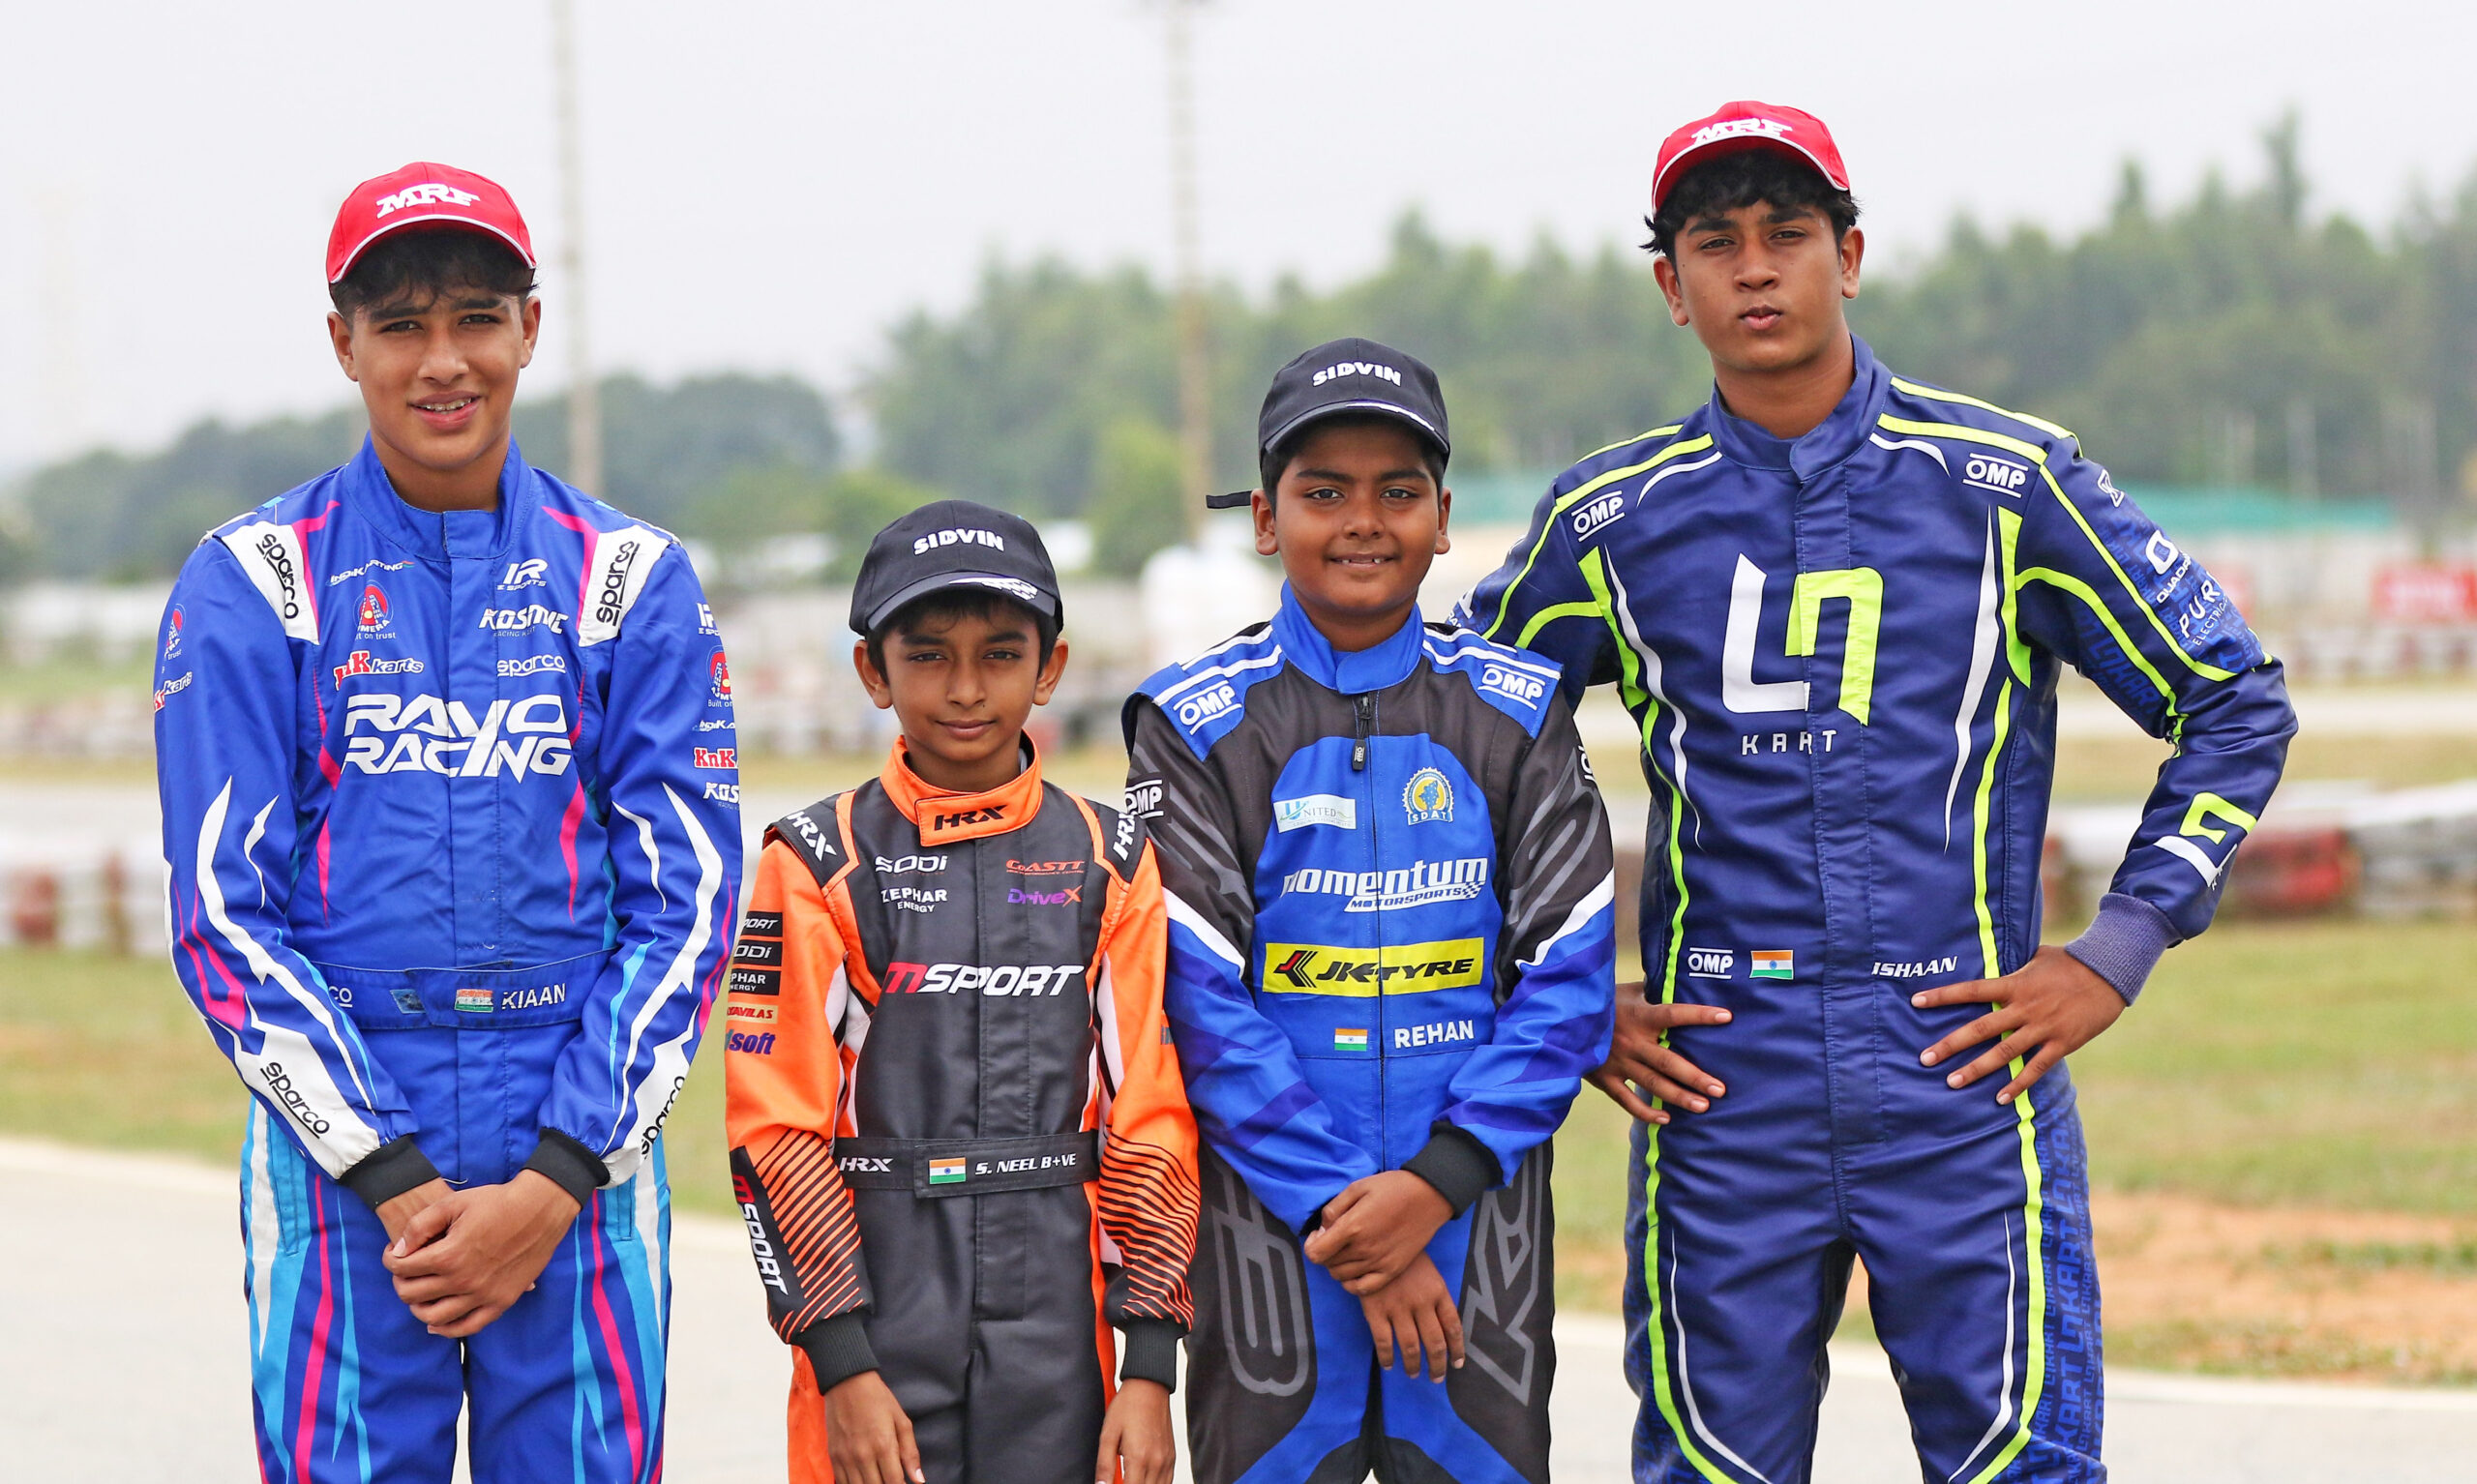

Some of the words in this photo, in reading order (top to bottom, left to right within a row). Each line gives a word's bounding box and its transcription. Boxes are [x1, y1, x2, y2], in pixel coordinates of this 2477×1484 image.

[1691, 117, 1793, 145] MRF
[375, 183, 481, 219] MRF
[1313, 362, 1401, 387] SIDVIN
[1965, 459, 2026, 490] OMP
[1573, 495, 1624, 535] OMP
[913, 528, 1004, 555] SIDVIN
[255, 532, 299, 620] sparco
[596, 541, 641, 627] sparco
[2156, 553, 2192, 604] QUADR
[2179, 571, 2223, 638] PUR
[478, 604, 569, 635] KOSMIC
[496, 654, 566, 677] sparco
[1481, 668, 1543, 700] OMP
[343, 694, 568, 739] RAYO
[1179, 685, 1236, 727] OMP
[1742, 729, 1836, 756] KART
[341, 732, 573, 784] RACING
[702, 782, 739, 804] KOS
[1125, 786, 1163, 814] OMP
[934, 805, 1007, 831] HRX
[1412, 810, 1447, 822] SDAT
[786, 811, 837, 862] HRX
[880, 887, 947, 903] ZEPHAR
[897, 901, 936, 913] ENERGY
[1007, 884, 1083, 907] DriveX
[1351, 887, 1461, 907] MOTORSPORTS
[1687, 953, 1734, 975] OMP
[1871, 957, 1957, 978] ISHAAN
[731, 972, 766, 984] PHAR
[501, 983, 566, 1010] KIAAN
[1394, 1020, 1475, 1049] REHAN
[260, 1061, 330, 1140] sparco
[839, 1156, 893, 1172] HRX
[975, 1162, 993, 1175] S.
[997, 1158, 1037, 1173] NEEL
[1040, 1153, 1077, 1169] B+VE
